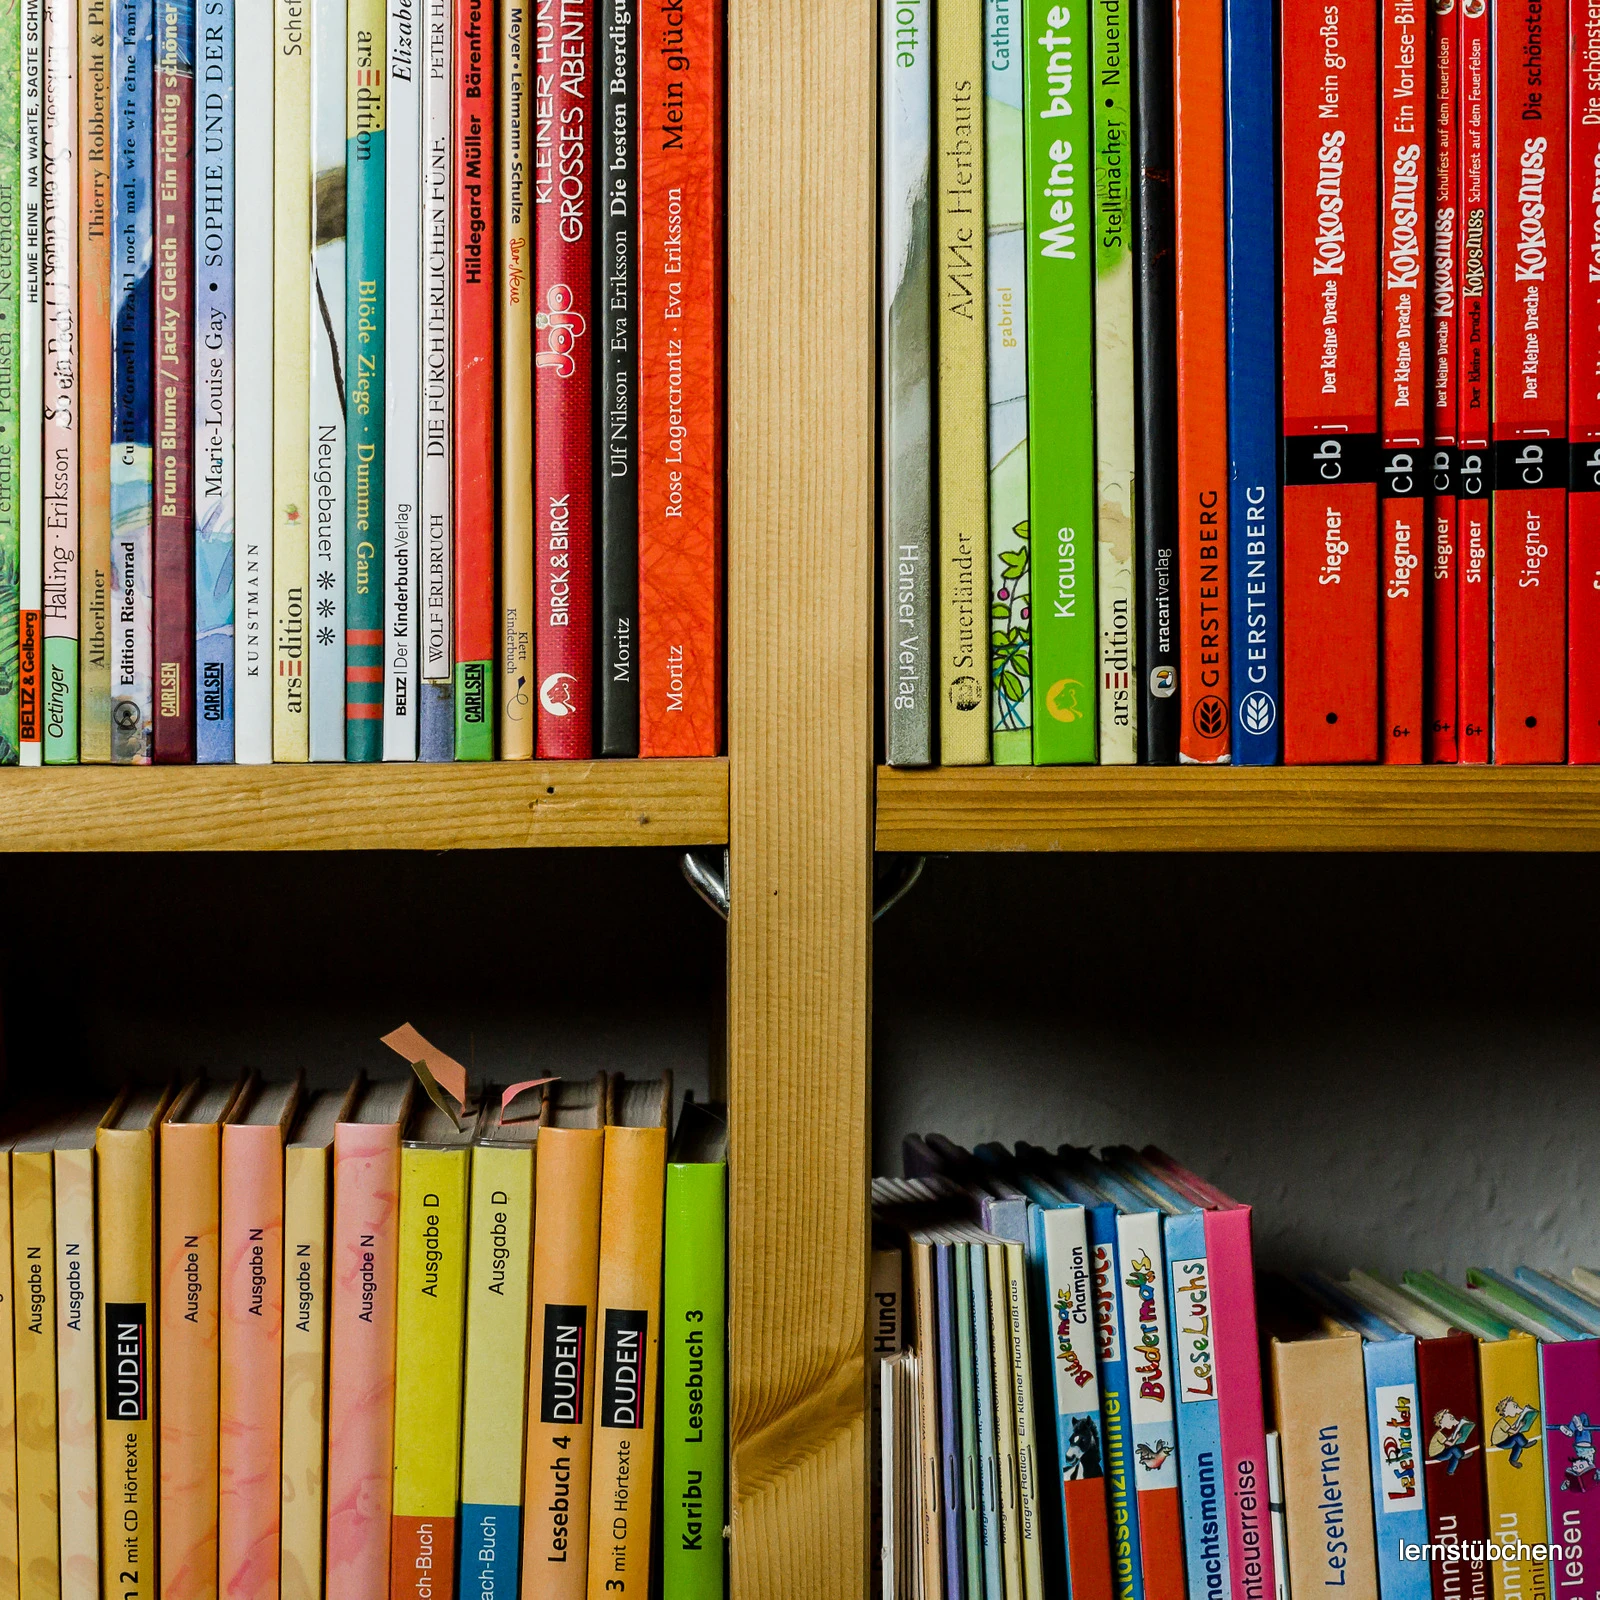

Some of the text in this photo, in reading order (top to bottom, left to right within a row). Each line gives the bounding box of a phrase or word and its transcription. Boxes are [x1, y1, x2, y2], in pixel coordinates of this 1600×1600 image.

[1319, 5, 1347, 69] großes
[1437, 38, 1449, 100] Feuerfelsen
[124, 56, 136, 92] eine
[1318, 74, 1339, 118] Mein
[87, 54, 109, 241] Thierry Robberecht
[124, 99, 136, 131] wir
[511, 8, 524, 224] Meyer Lehmann Schulze
[537, 73, 556, 204] KLEINER
[610, 103, 627, 170] besten
[661, 81, 683, 151] Mein
[946, 80, 973, 215] Herbauts
[1038, 5, 1076, 260] Meine bunte
[1393, 105, 1414, 133] Ein
[1437, 128, 1449, 147] auf
[1438, 103, 1449, 125] dem
[26, 47, 40, 303] HELME HEINE NA WARTE, SAGTE
[124, 139, 136, 170] wie
[559, 106, 585, 242] GROSSES
[1101, 119, 1122, 248] Stellmacher
[1437, 151, 1450, 201] Schulfest
[466, 115, 485, 284] Hildegard Müller
[610, 178, 627, 218] Die
[663, 187, 682, 274] Eriksson
[123, 224, 136, 264] noch
[159, 3, 181, 516] Bruno Blume Jacky Gleich Ein richtig schöner
[205, 25, 227, 497] Marie-Louise Gay SOPHIE UND DER
[610, 230, 627, 311] Eriksson
[536, 283, 586, 378] Jojo
[611, 317, 627, 351] Eva
[664, 281, 682, 319] Eva
[997, 287, 1017, 348] gabriel
[1322, 280, 1338, 325] Drache
[1396, 294, 1411, 338] Drache
[1320, 327, 1338, 369] kleine
[1394, 341, 1411, 382] kleine
[1435, 357, 1449, 388] kleine
[1437, 321, 1448, 355] Drache
[611, 371, 628, 441] Nilsson
[665, 339, 688, 464] Lagercrantz
[1321, 371, 1337, 394] Der
[1395, 384, 1410, 407] Der
[1436, 389, 1447, 407] Der
[355, 280, 377, 595] Blöde Ziege Dumme Gans
[610, 444, 628, 478] Ulf
[314, 424, 337, 562] Neugebauer
[665, 471, 683, 518] Rose
[44, 448, 74, 620] Halling Eriksson
[550, 494, 571, 627] BIRCK BIRCK
[1318, 506, 1349, 585] Siegner
[1387, 519, 1418, 598] Siegner
[1434, 517, 1452, 579] Siegner
[429, 514, 444, 663] WOLF ERLBRUCH
[952, 531, 974, 668] Sauerländer
[1053, 527, 1076, 618] Krause
[1199, 490, 1219, 687] GERSTENBERG
[1246, 485, 1267, 683] GERSTENBERG
[89, 570, 105, 668] Altberliner
[121, 542, 135, 685] Edition Riesenrad
[247, 543, 259, 677] KUNSTMANN
[506, 608, 517, 674] Kinderbuch
[894, 544, 919, 710] Hanser Verlag
[21, 612, 37, 740] BELTZ Gelberg
[394, 642, 408, 668] Der
[517, 632, 528, 660] Klett
[613, 617, 631, 683] Moritz
[666, 644, 684, 712] Moritz
[47, 664, 68, 738] Oetinger
[161, 662, 179, 717] CARLSEN
[204, 662, 223, 721] CARLSEN
[396, 677, 406, 716] BELTZ
[1393, 725, 1411, 738] 6+
[421, 1193, 442, 1298] Ausgabe D
[488, 1191, 509, 1296] Ausgabe D
[27, 1246, 44, 1334] Ausgabe N
[66, 1243, 84, 1331] Ausgabe N
[1009, 1279, 1019, 1302] aus
[1070, 1246, 1089, 1325] Champion
[874, 1291, 896, 1352] Hund
[1012, 1336, 1023, 1369] Hund
[117, 1322, 140, 1416] DUDEN
[553, 1324, 578, 1420] DUDEN
[613, 1330, 638, 1424] DUDEN
[1014, 1372, 1026, 1414] kleiner
[682, 1309, 703, 1550] Karibu Lesebuch 3
[1018, 1416, 1027, 1436] Ein
[122, 1432, 138, 1503] Hörtexte
[548, 1435, 571, 1563] Lesebuch 4
[1018, 1448, 1028, 1490] Rettich
[124, 1509, 138, 1532] CD
[606, 1439, 631, 1593] 3 mit CD Hörtexte
[1021, 1493, 1033, 1540] Margret
[1317, 1424, 1348, 1586] Lesenlernen
[119, 1571, 138, 1584] 2
[124, 1537, 138, 1563] mit
[1560, 1510, 1585, 1586] lesen
